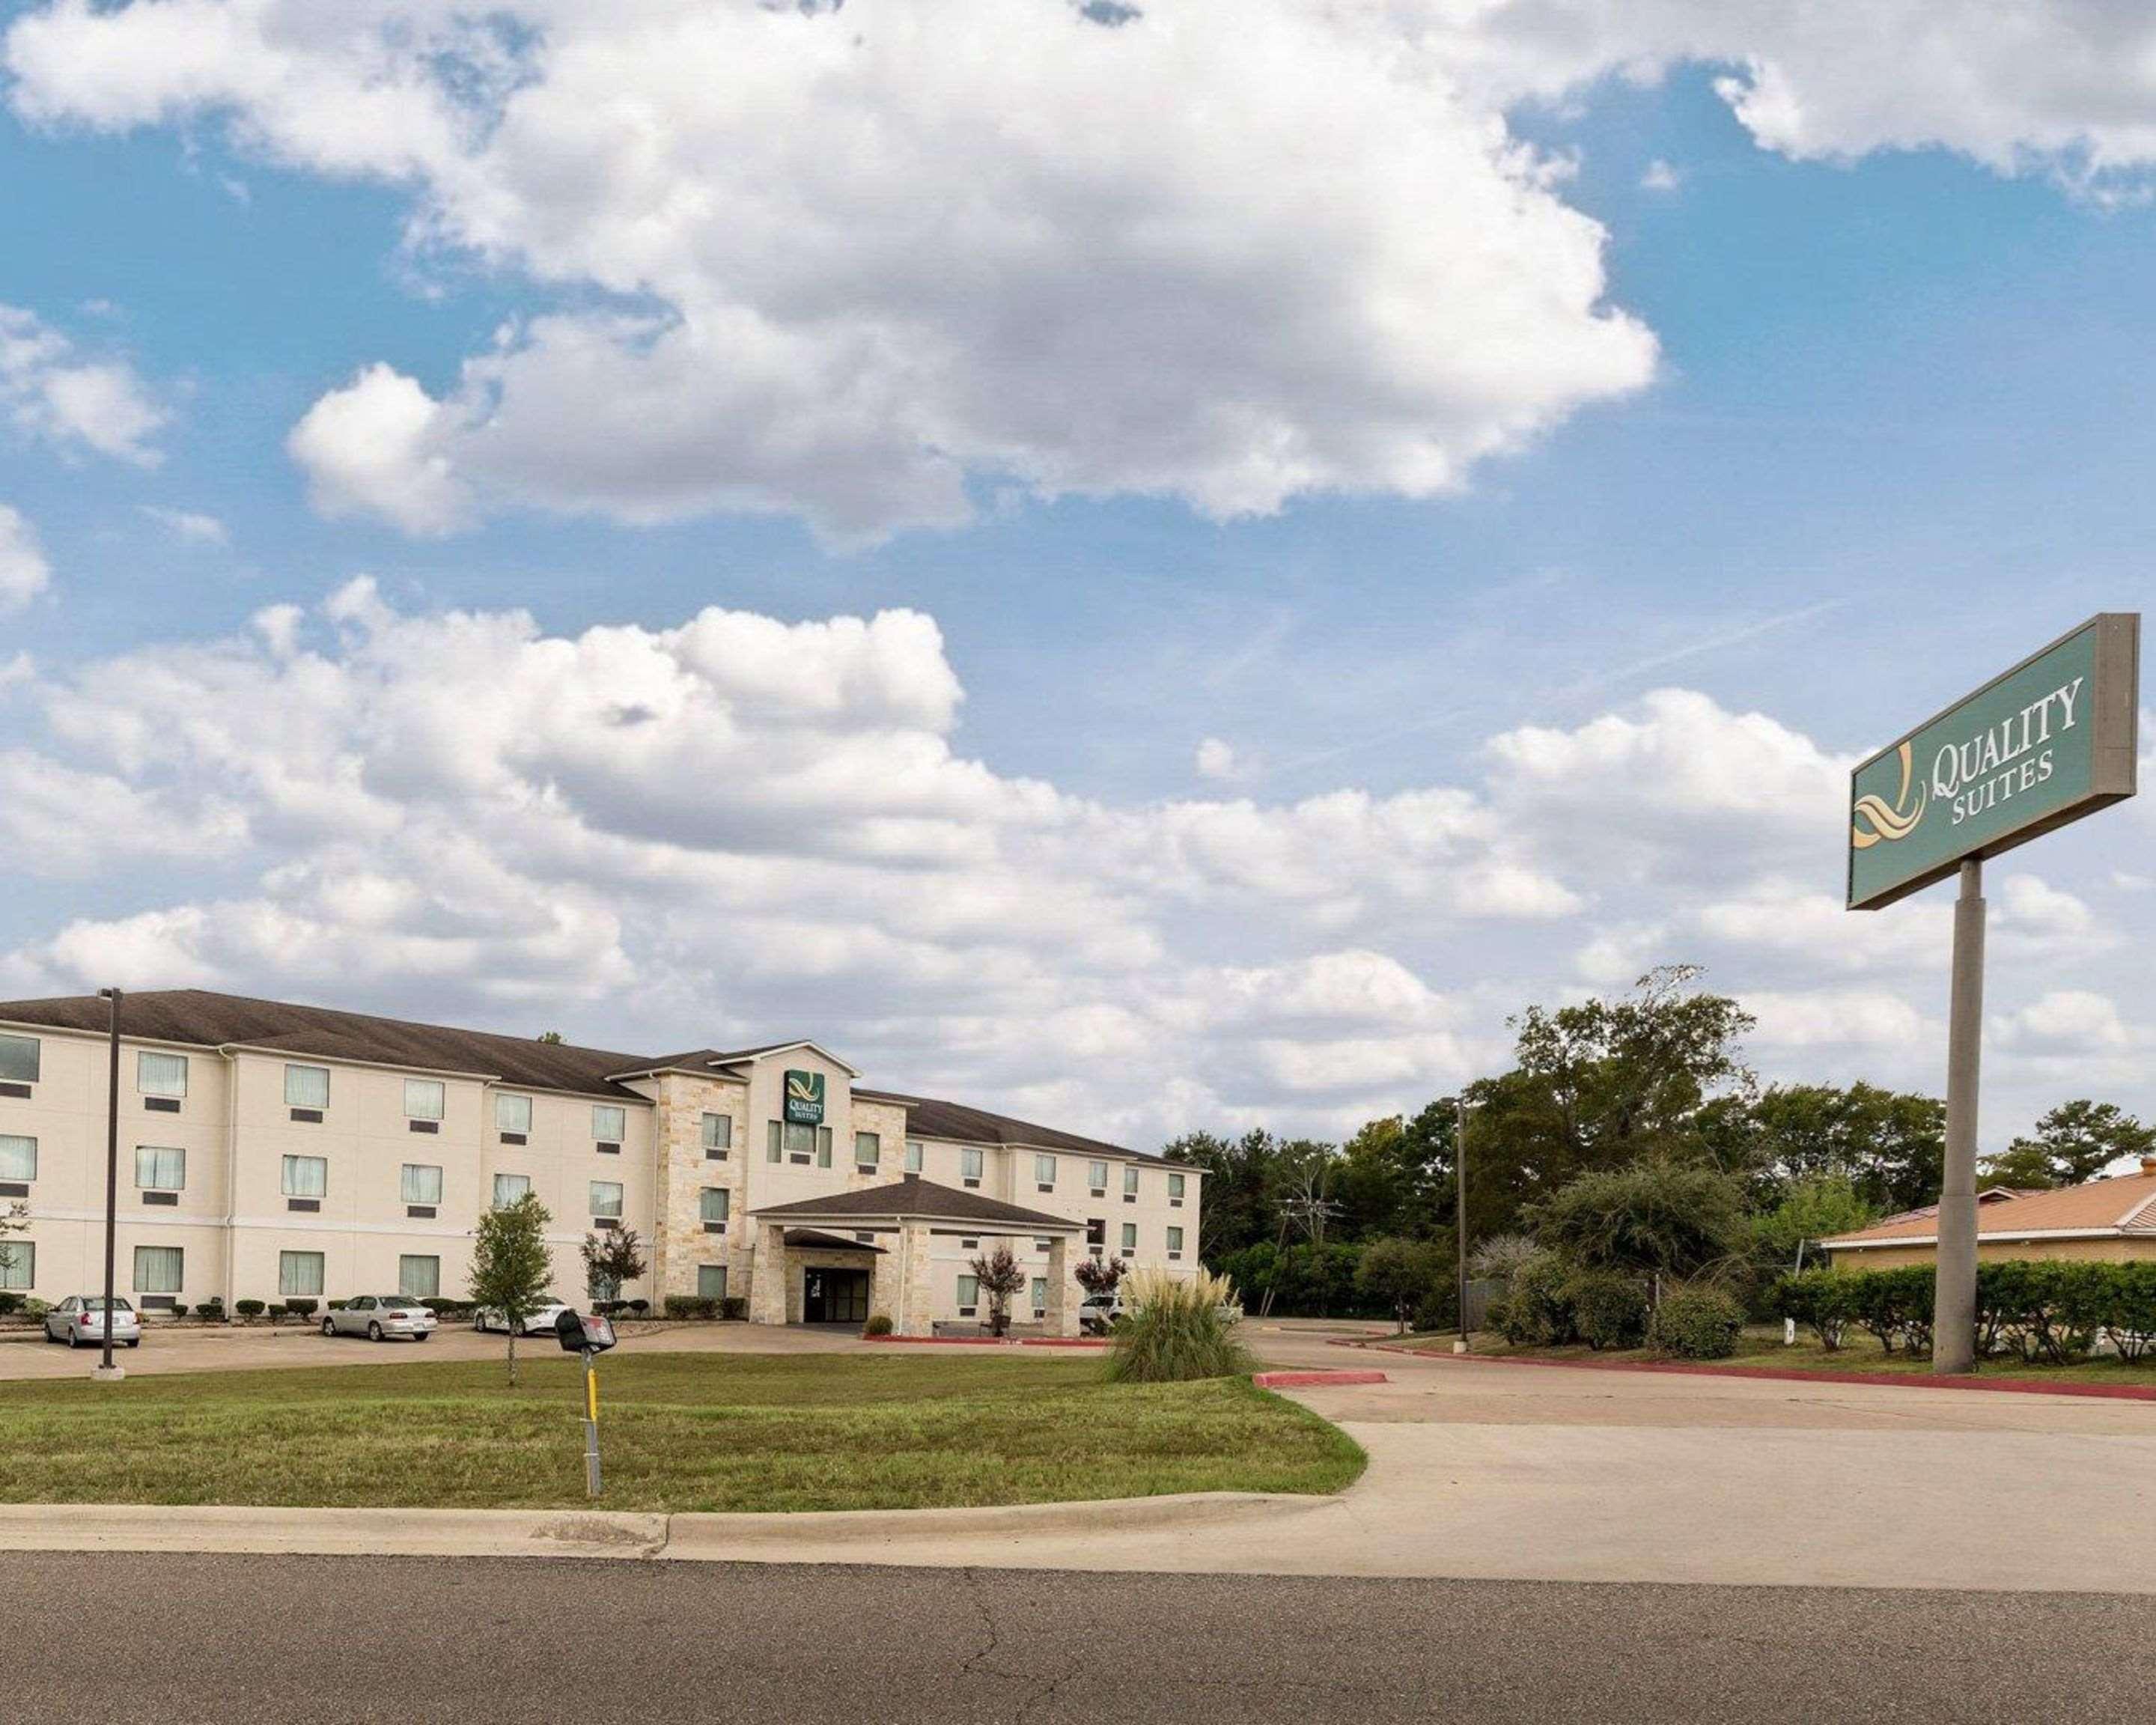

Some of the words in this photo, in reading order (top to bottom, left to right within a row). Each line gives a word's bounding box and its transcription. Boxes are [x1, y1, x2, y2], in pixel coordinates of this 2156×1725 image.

[1932, 677, 2083, 801] QUALITY
[1952, 749, 2053, 825] SUITES
[790, 1098, 823, 1113] QUALITY
